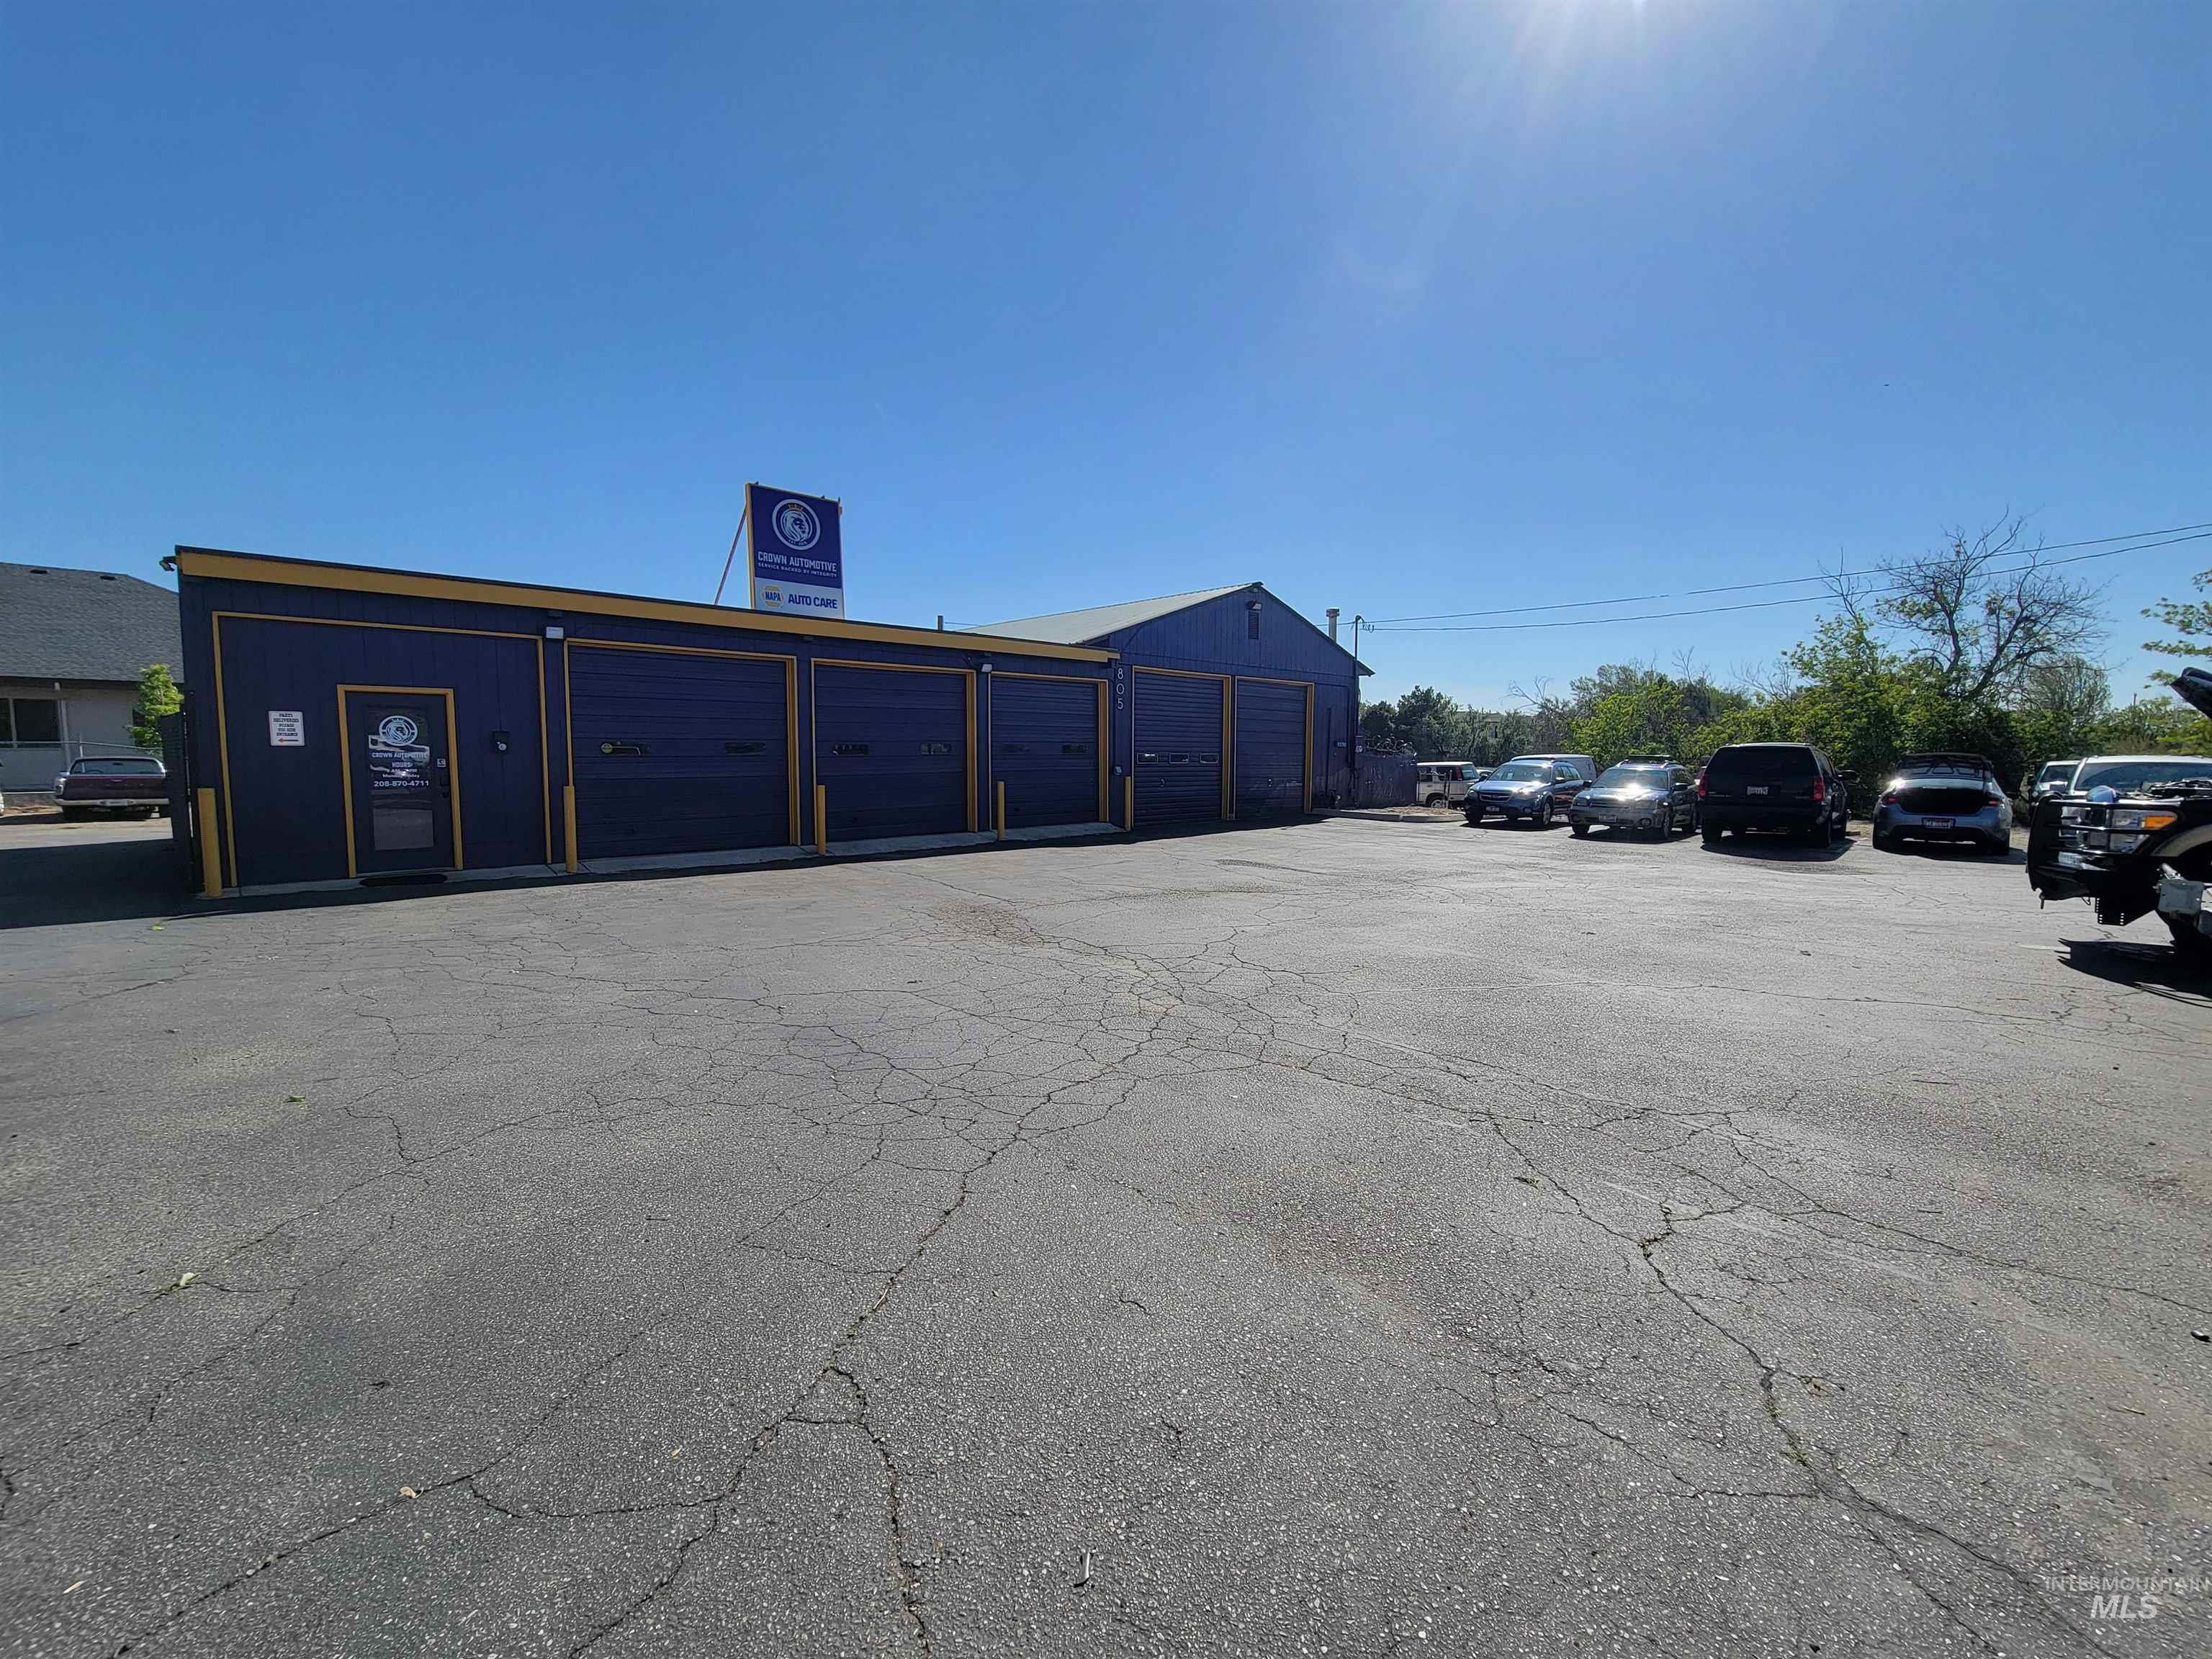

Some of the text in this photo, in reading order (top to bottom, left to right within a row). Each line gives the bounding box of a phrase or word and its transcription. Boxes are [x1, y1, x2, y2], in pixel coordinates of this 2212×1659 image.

[758, 552, 837, 572] CROWN AUTOMOTIVE
[765, 591, 781, 602] NAPA
[788, 594, 837, 609] AUTO CARE
[1116, 667, 1125, 710] 805
